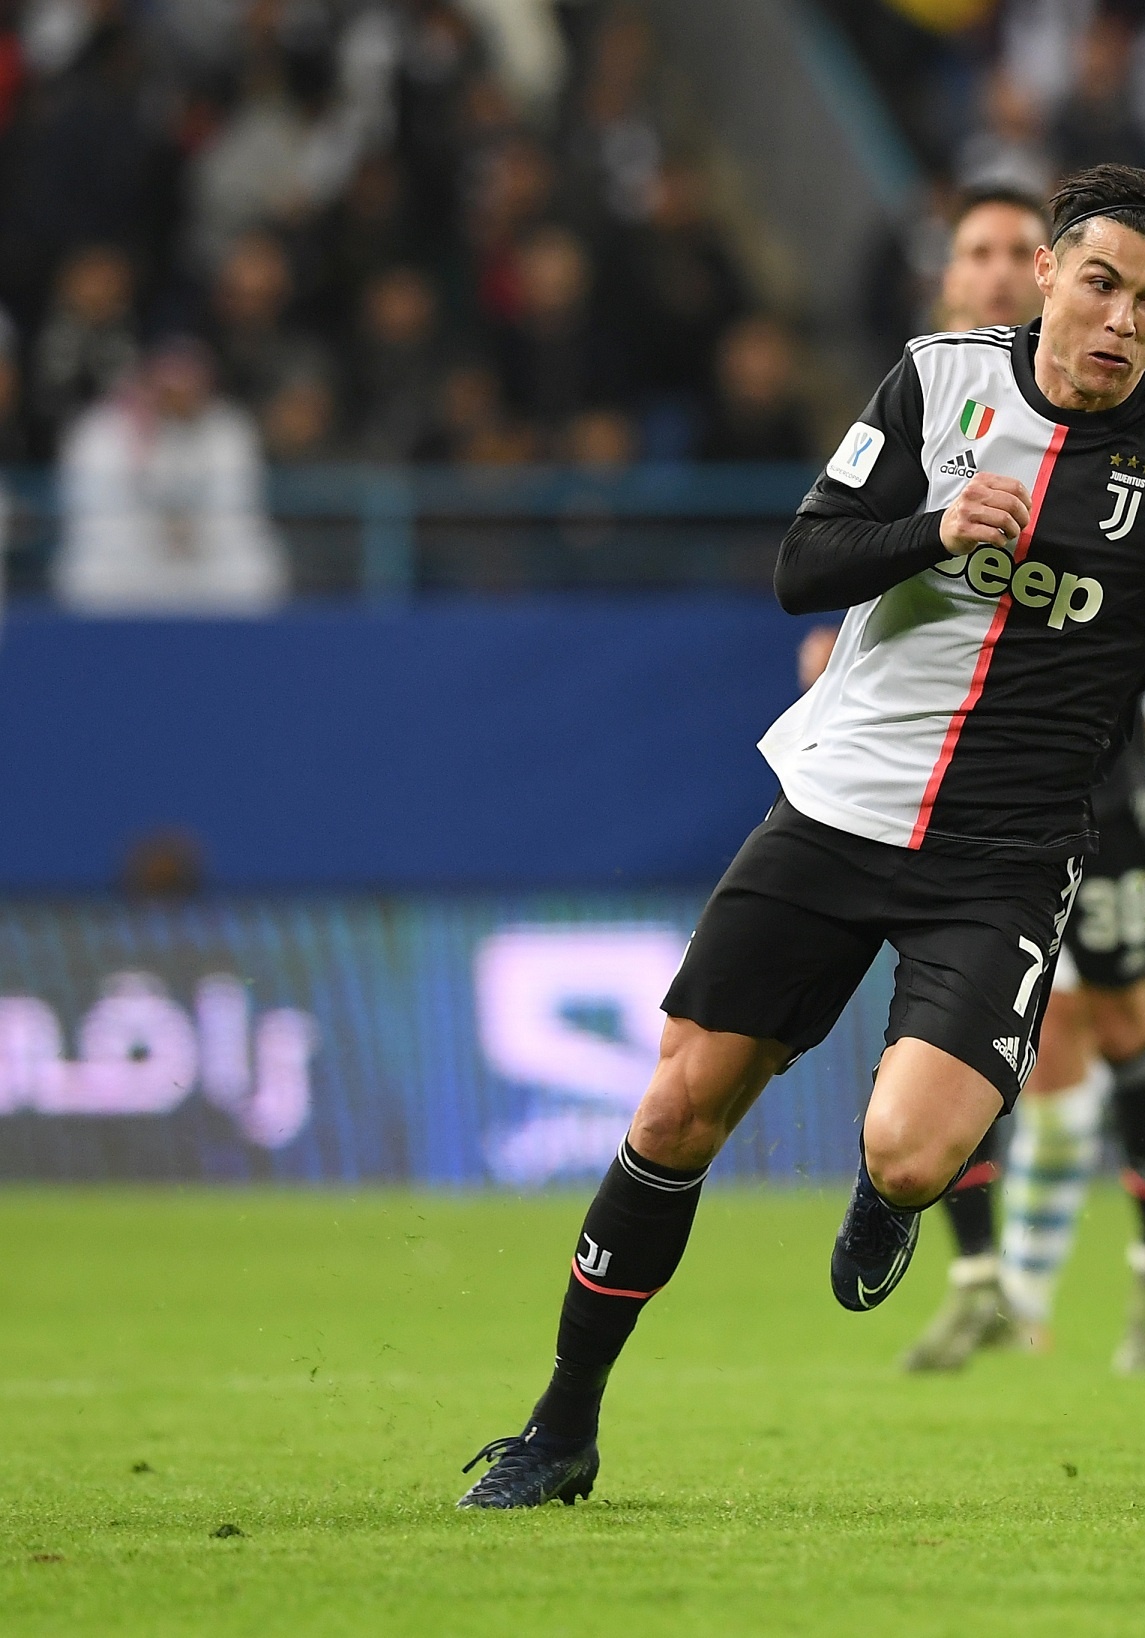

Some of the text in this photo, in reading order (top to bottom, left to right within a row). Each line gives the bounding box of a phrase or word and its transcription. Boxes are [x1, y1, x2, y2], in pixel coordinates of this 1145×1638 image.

[829, 464, 863, 484] SUPERCOPPA
[940, 464, 975, 479] adida
[1013, 935, 1044, 1018] 7
